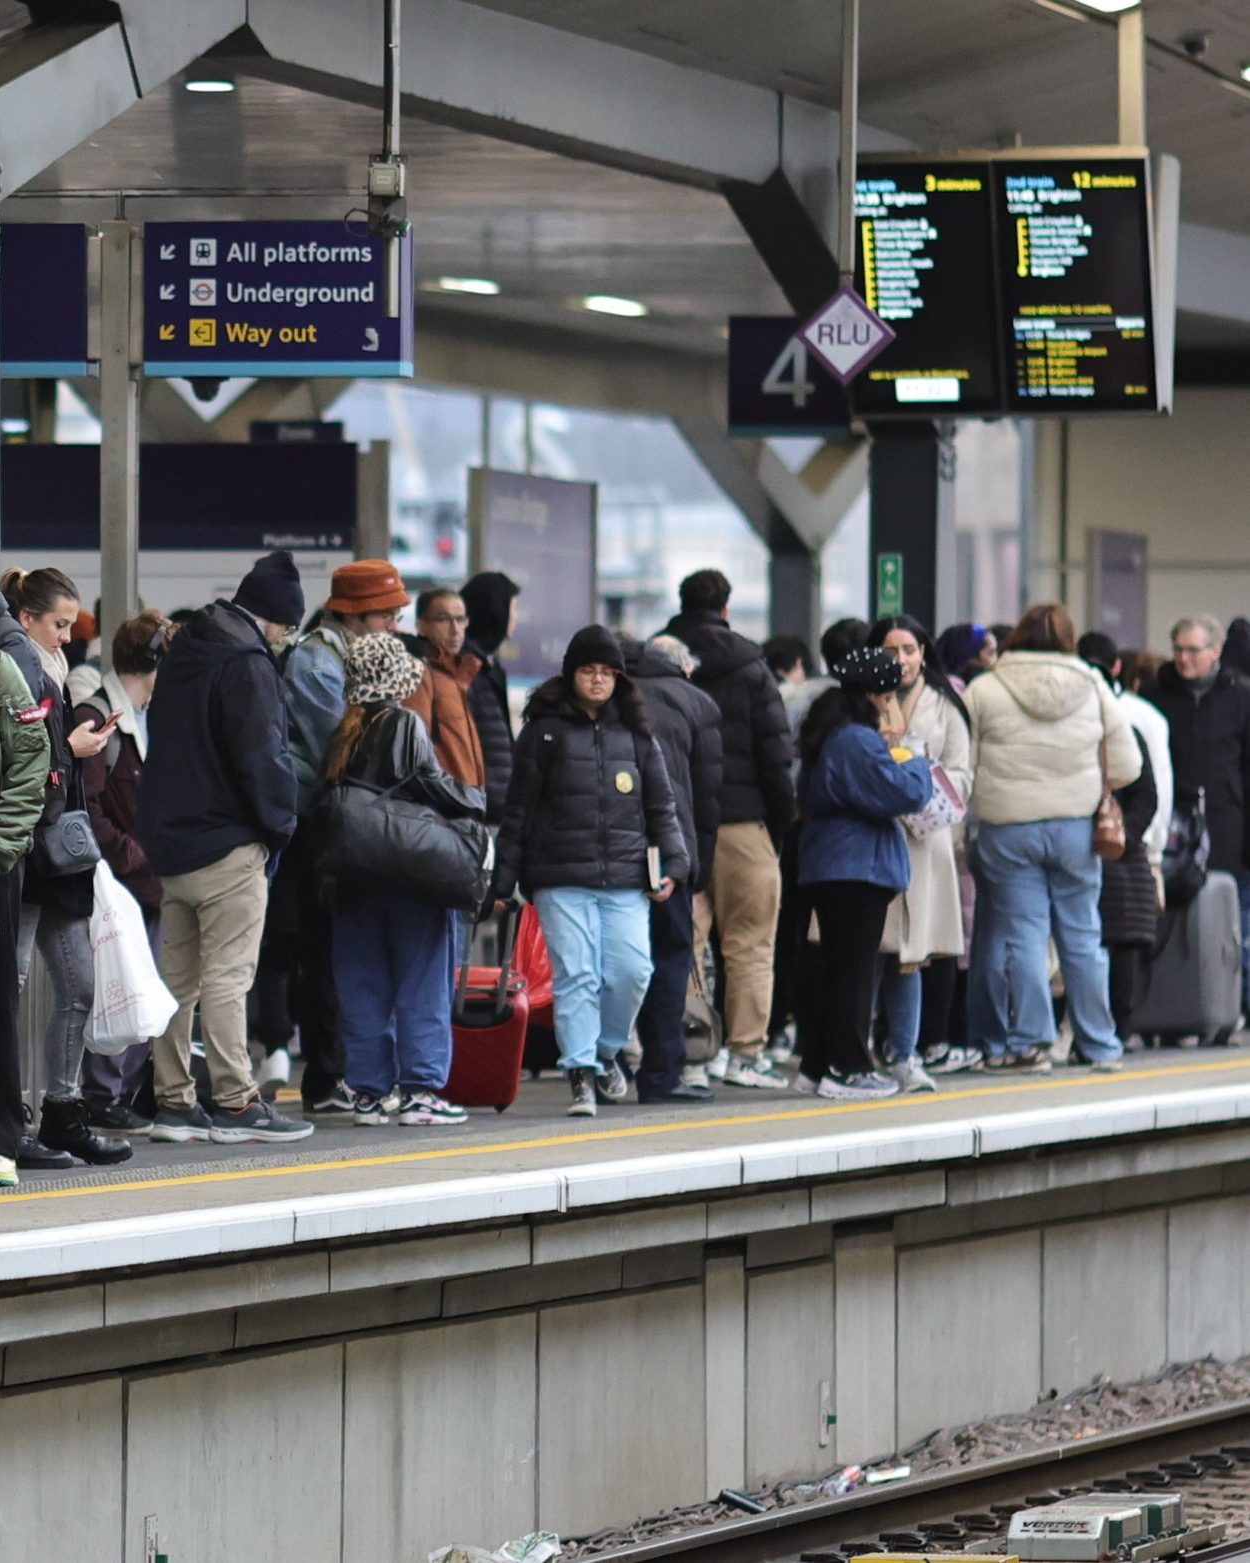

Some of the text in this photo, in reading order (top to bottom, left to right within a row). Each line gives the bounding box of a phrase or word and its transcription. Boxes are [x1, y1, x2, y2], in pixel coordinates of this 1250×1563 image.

[925, 174, 981, 192] 3 minutes
[1072, 171, 1136, 188] 12 minutes
[226, 242, 372, 267] All platforms
[226, 281, 375, 307] Underground
[225, 322, 317, 347] Way out
[817, 324, 871, 345] RLU
[762, 336, 815, 408] 4
